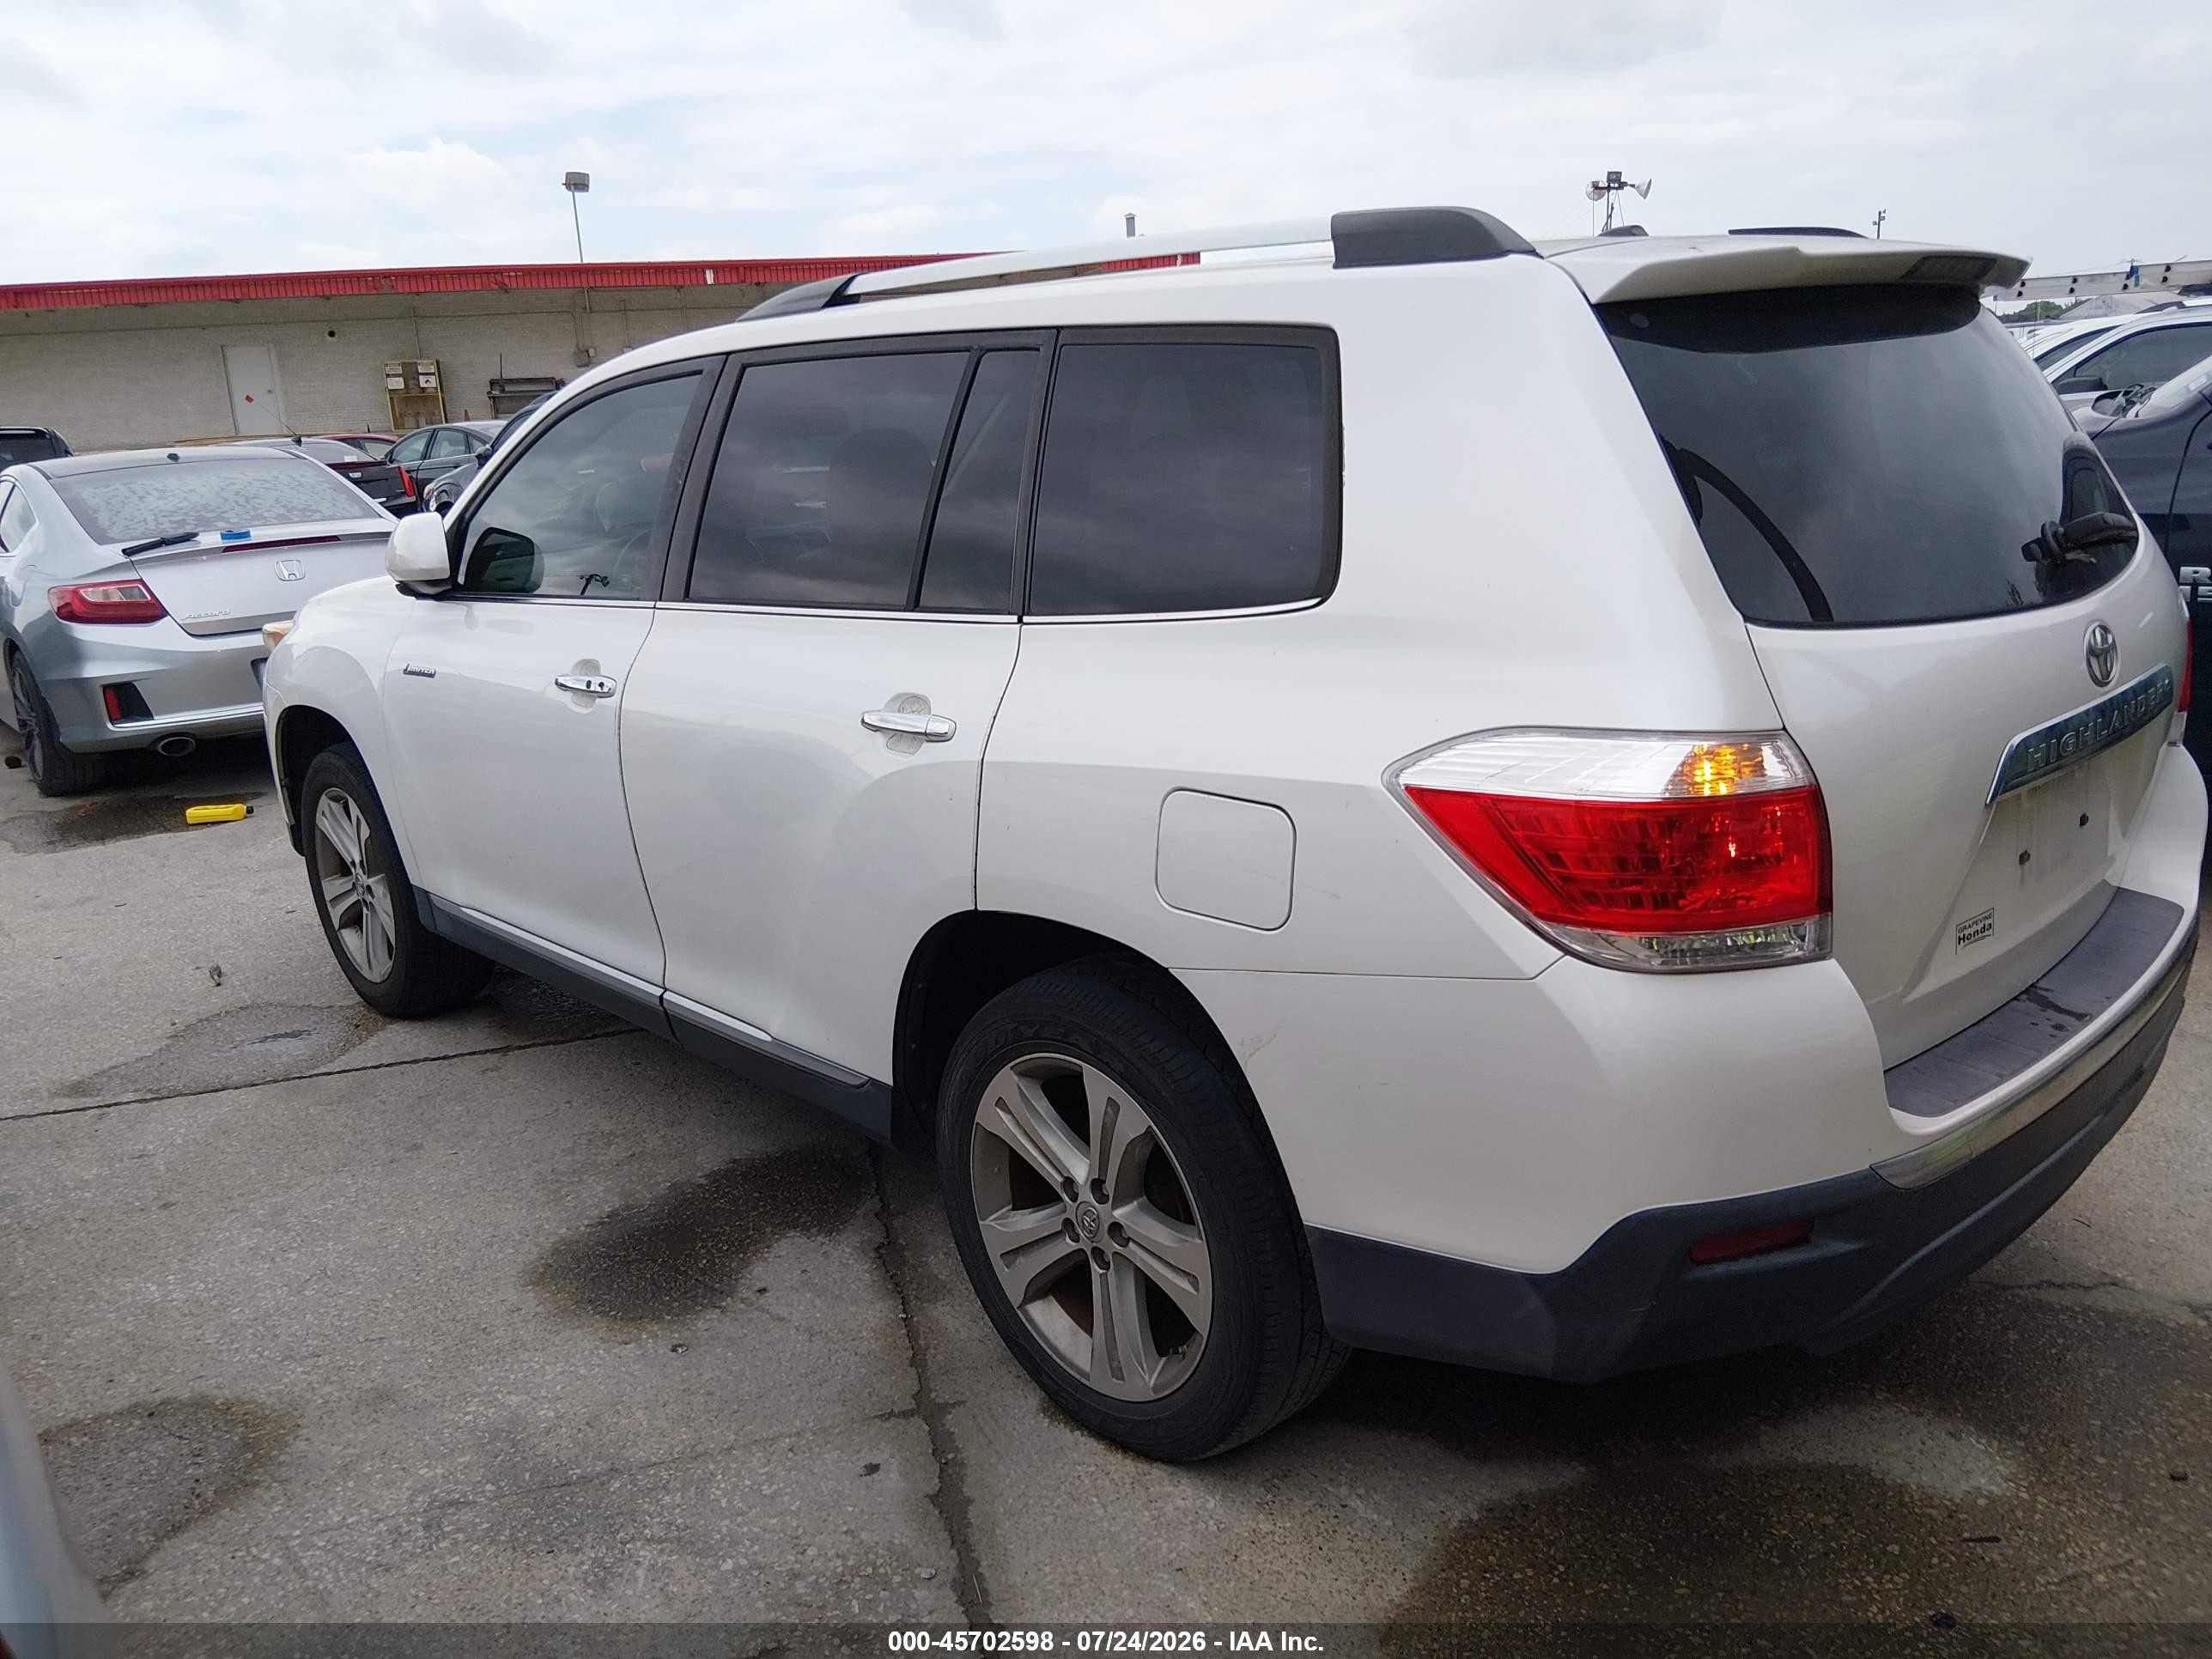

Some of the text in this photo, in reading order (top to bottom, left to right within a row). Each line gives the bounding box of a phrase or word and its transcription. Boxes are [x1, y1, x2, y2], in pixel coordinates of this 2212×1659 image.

[179, 605, 232, 621] Accord
[2026, 678, 2172, 772] HIGHLANDER
[1958, 912, 1993, 934] GRAPEVINE
[1958, 922, 1992, 945] Honda
